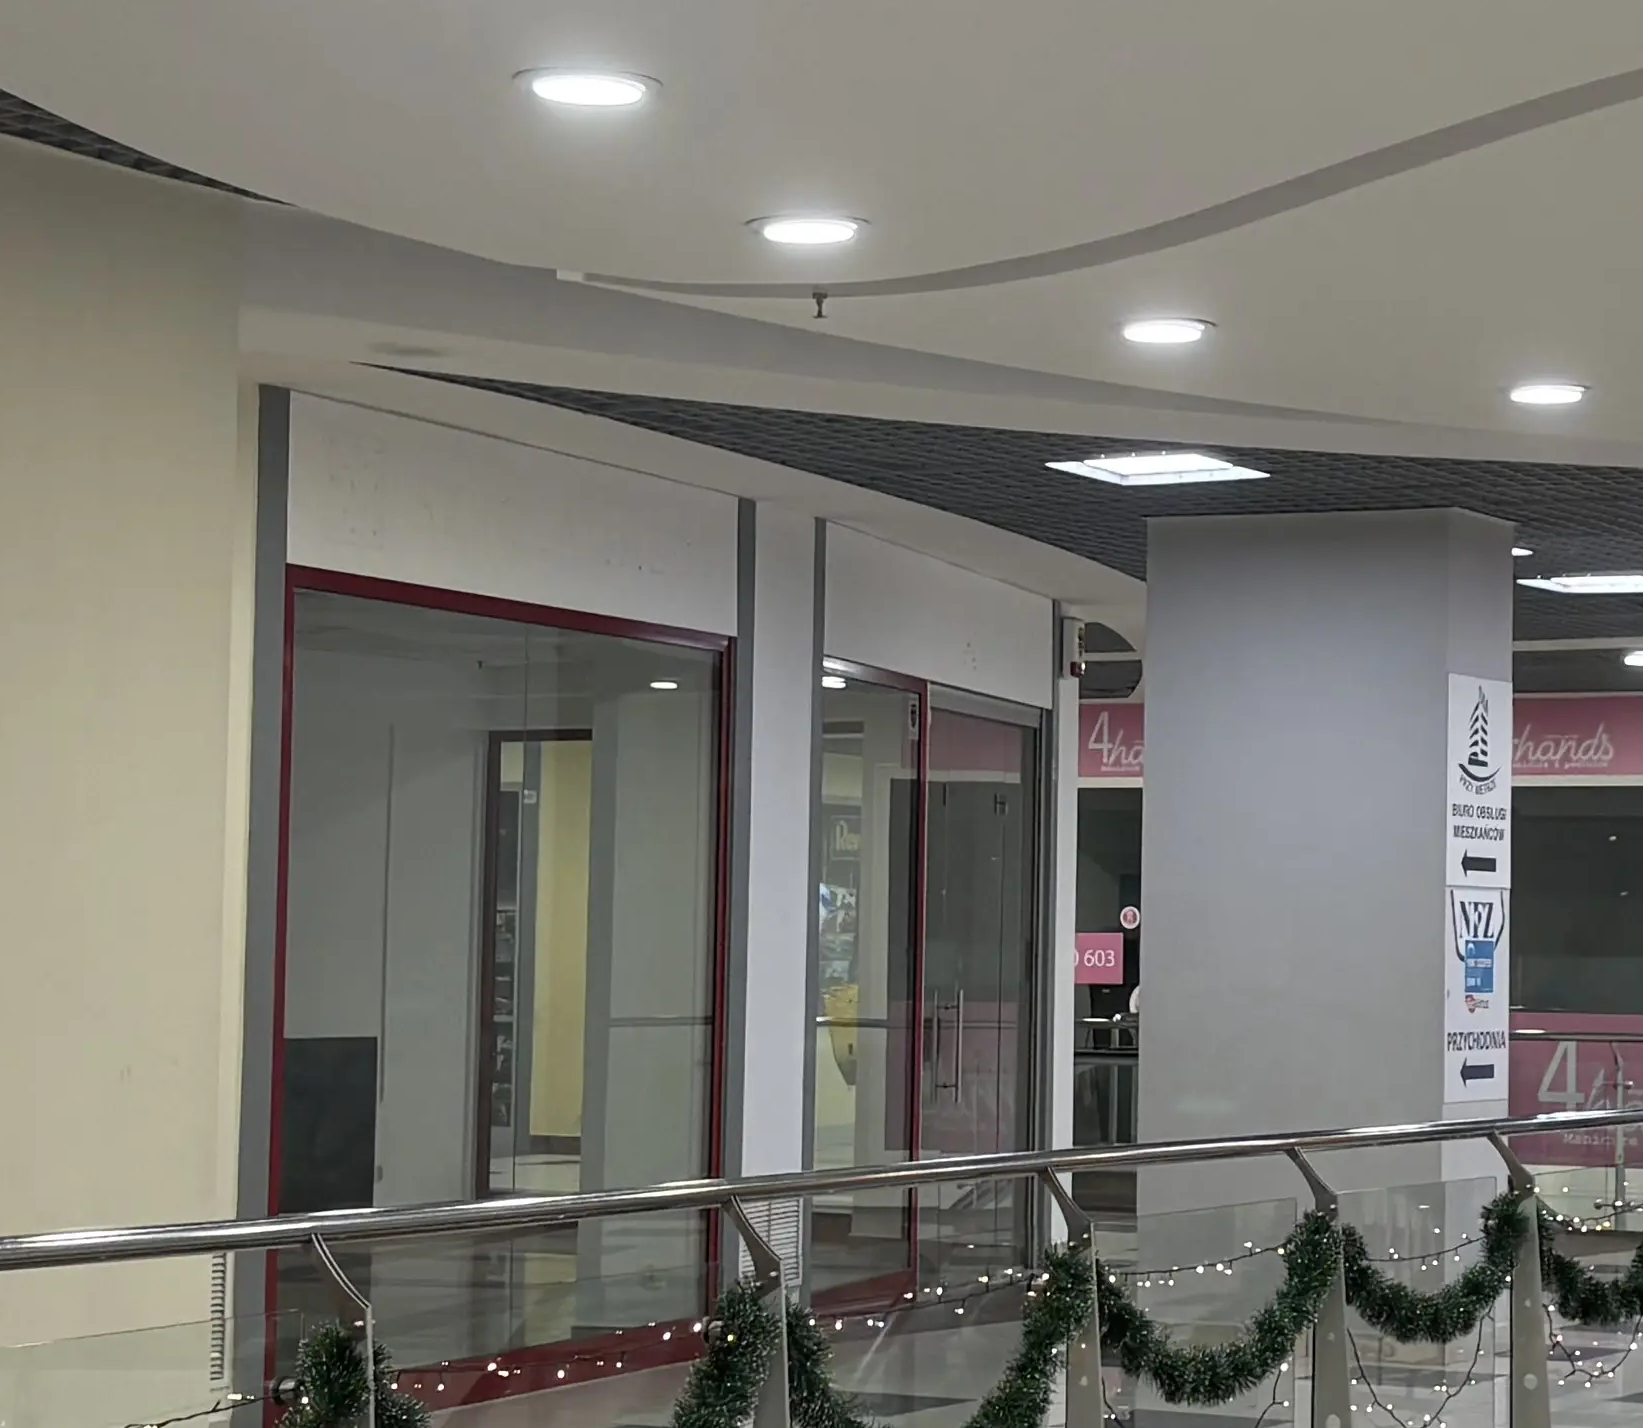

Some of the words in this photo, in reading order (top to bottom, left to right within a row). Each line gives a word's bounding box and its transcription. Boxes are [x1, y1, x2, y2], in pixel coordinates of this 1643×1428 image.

[1459, 900, 1494, 939] NFZ
[1083, 949, 1115, 967] 603
[1447, 1030, 1507, 1052] PRZYCHODNIA
